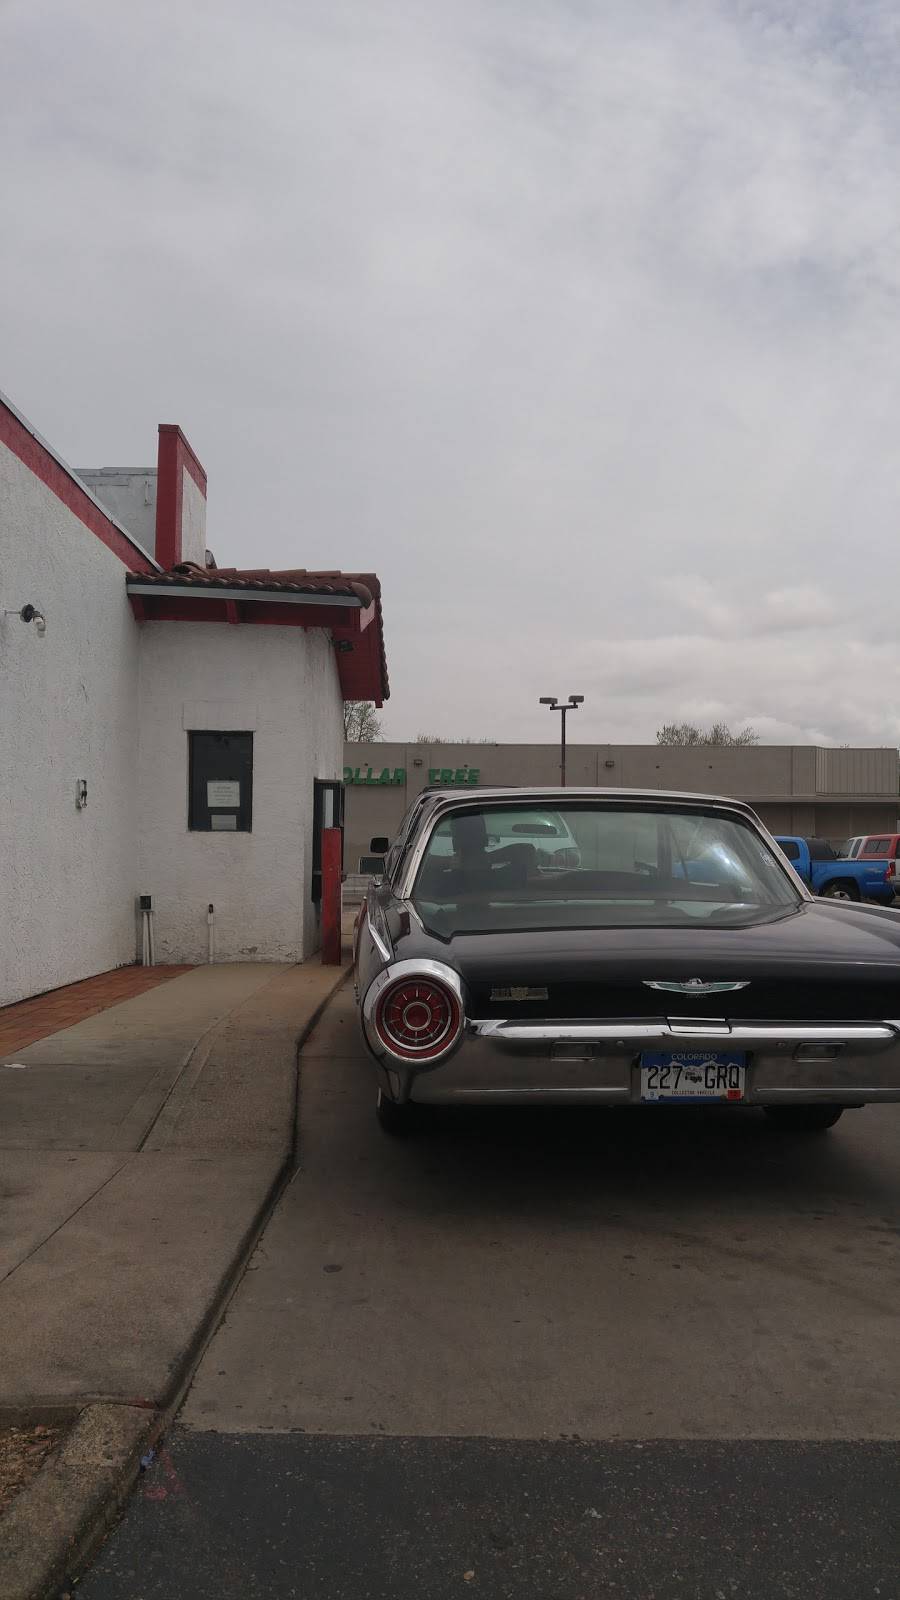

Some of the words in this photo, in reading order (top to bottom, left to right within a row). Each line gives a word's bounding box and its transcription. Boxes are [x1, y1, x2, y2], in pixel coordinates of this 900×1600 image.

[429, 768, 480, 785] TREE
[671, 1053, 717, 1061] COLORADO
[648, 1066, 683, 1089] 227
[704, 1066, 740, 1089] GRQ
